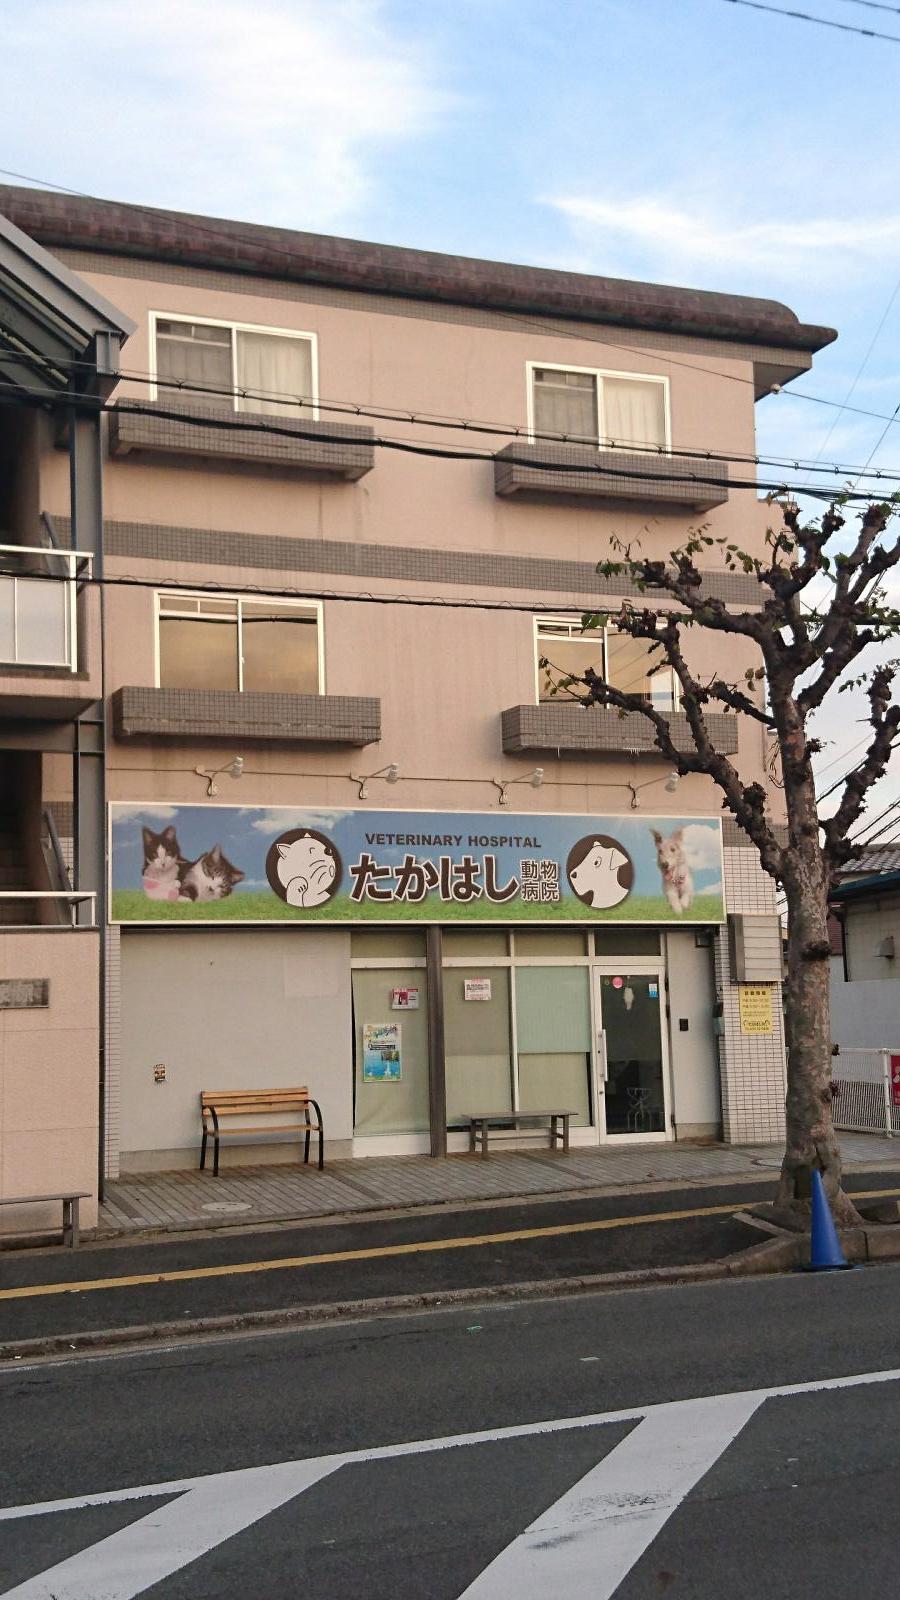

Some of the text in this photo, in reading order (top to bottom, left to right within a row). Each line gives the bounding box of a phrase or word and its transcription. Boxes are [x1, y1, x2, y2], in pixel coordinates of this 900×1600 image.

[365, 833, 541, 848] VETERINARY HOSPITAL
[350, 852, 519, 902] たかはし
[520, 859, 558, 879] 動物
[521, 880, 559, 900] 病院
